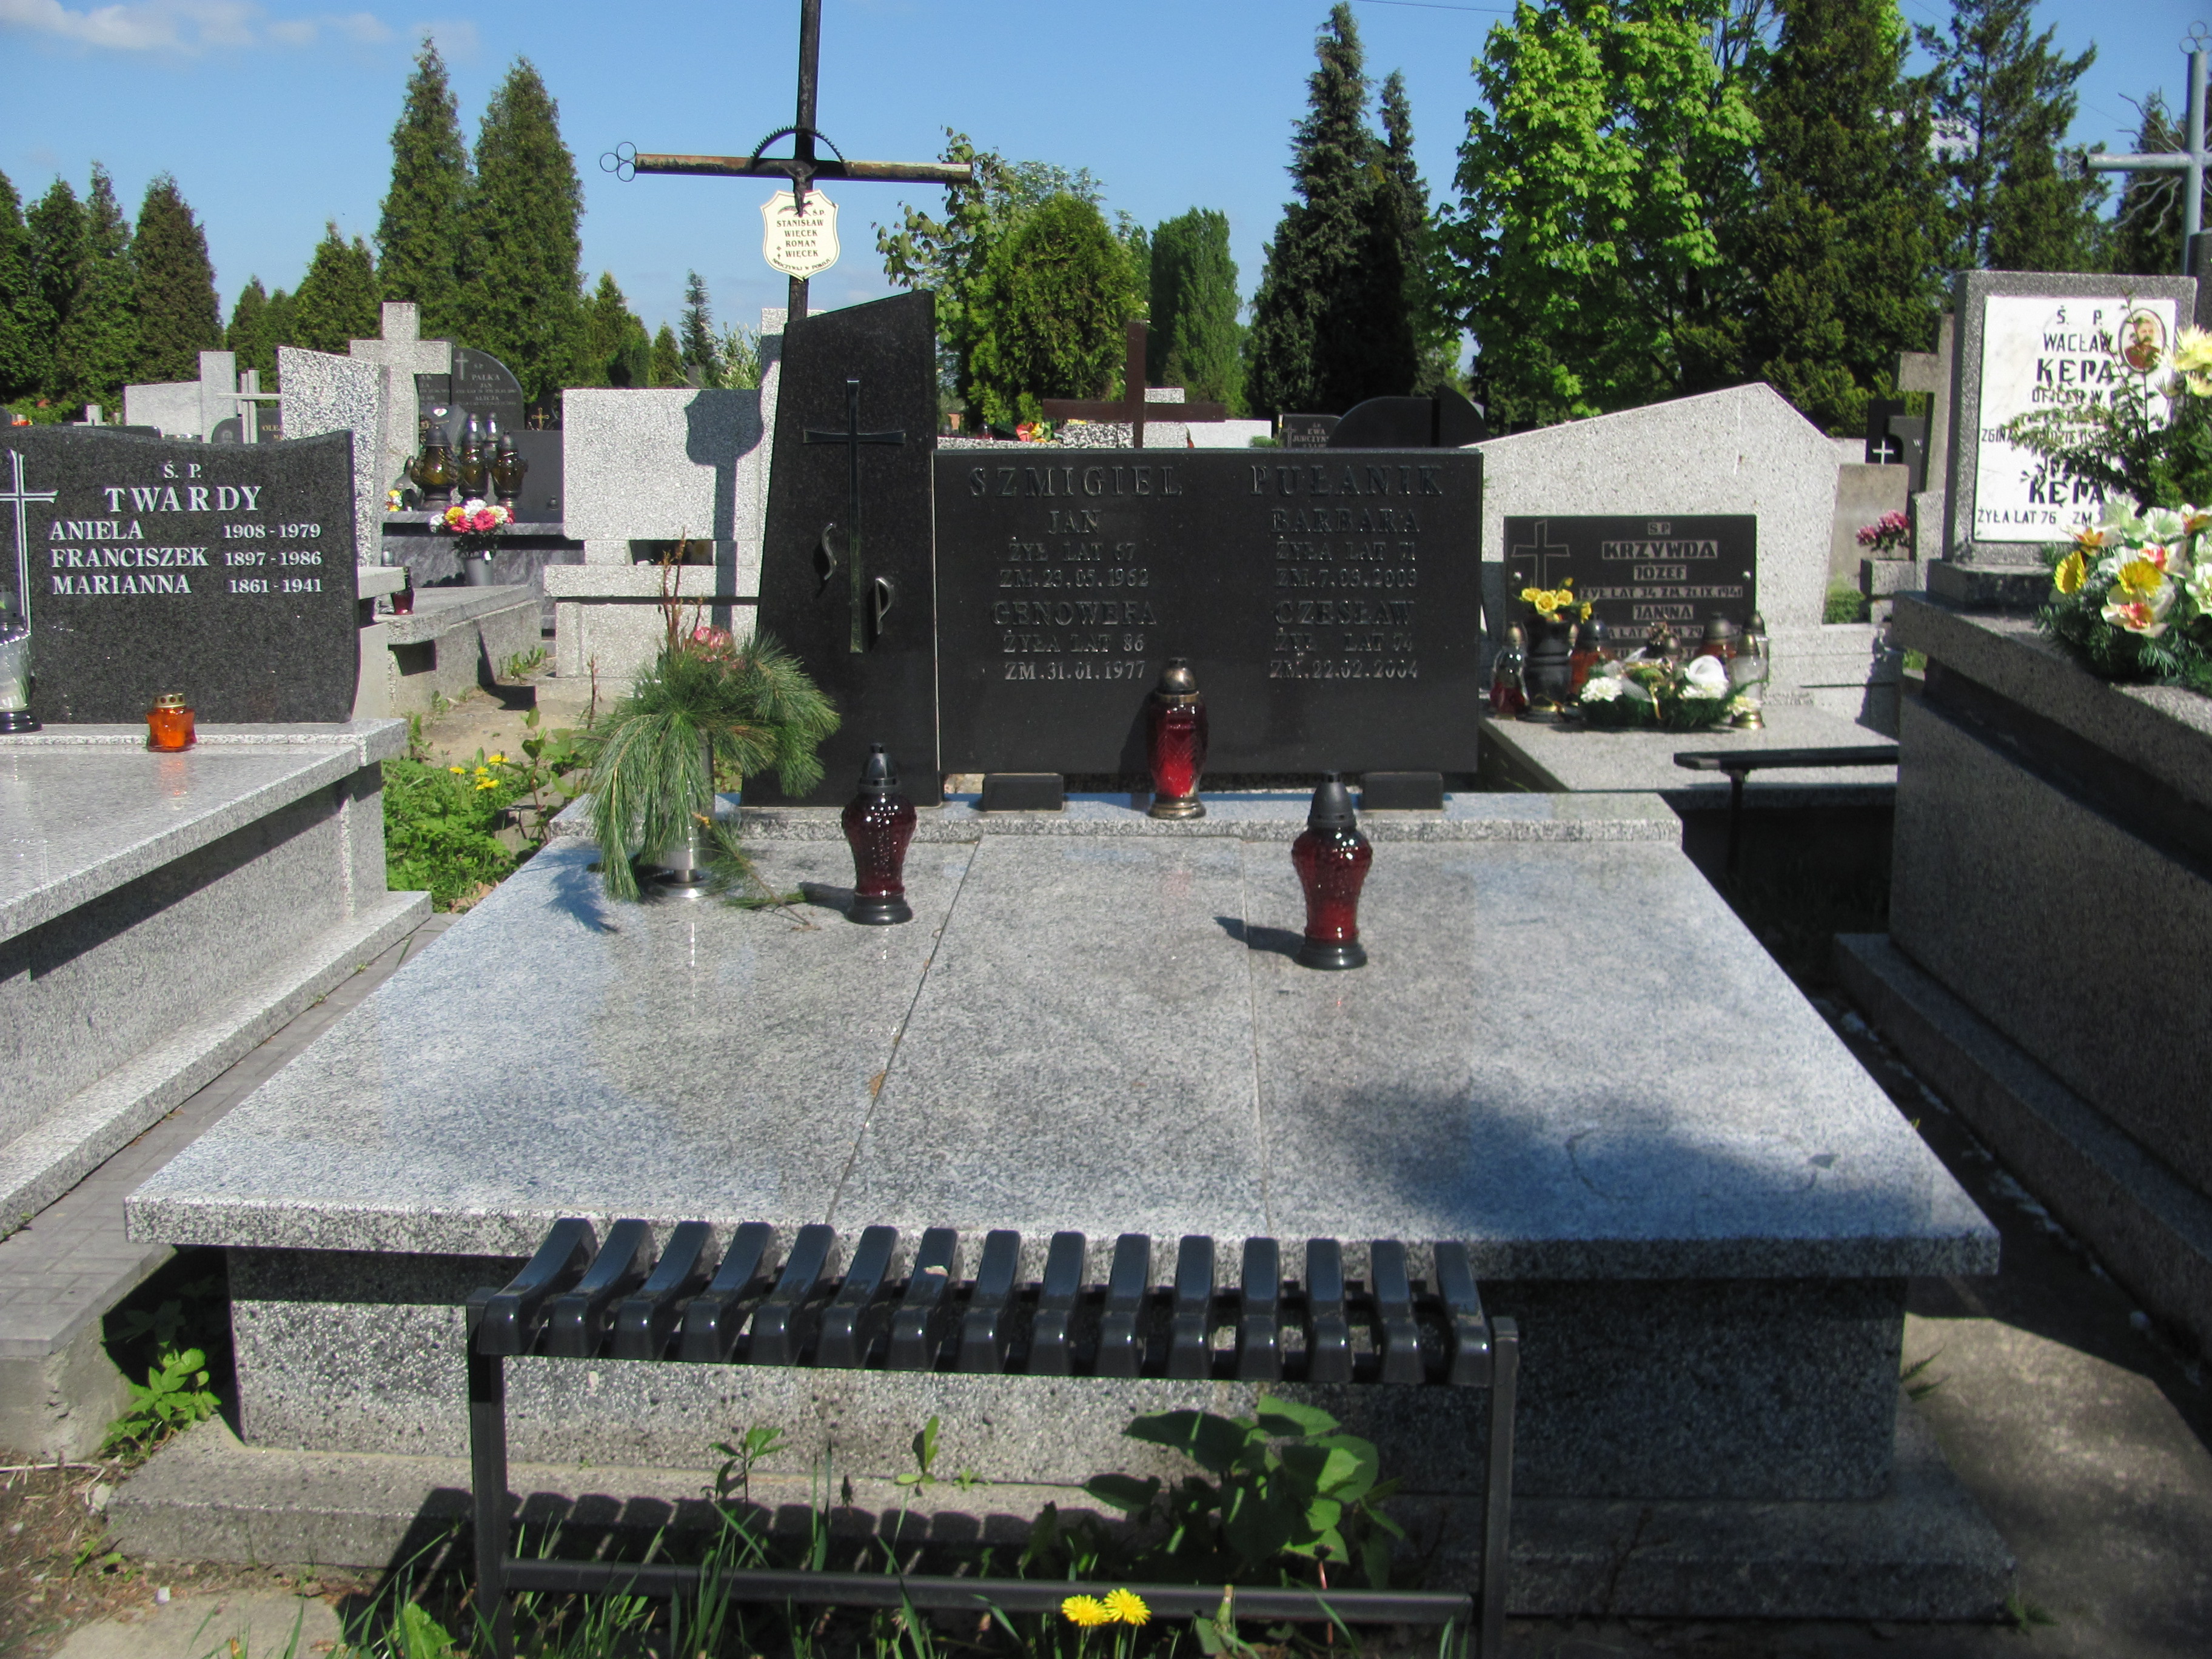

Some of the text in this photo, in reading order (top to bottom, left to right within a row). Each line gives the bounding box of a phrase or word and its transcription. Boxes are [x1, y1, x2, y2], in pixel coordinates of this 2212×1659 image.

[784, 230, 818, 238] WIĘCEK
[785, 250, 819, 259] WIĘCEK
[2037, 358, 2114, 386] KĘPA
[970, 466, 1183, 497] SZMIGIEL
[1250, 465, 1443, 497] PUŁANIK
[105, 485, 263, 513] TWARDY
[2029, 480, 2105, 508] KĘPA
[1048, 509, 1102, 535] JAN
[1270, 508, 1420, 533] BARBARA
[1977, 506, 2010, 524] ŻYŁA
[2014, 510, 2037, 524] LAT
[2040, 510, 2057, 525] 76
[49, 520, 145, 541] ANIELA
[50, 547, 210, 568] FRANCISZEK
[1062, 541, 1105, 562] LAT
[1114, 543, 1138, 562] 67
[1345, 541, 1387, 561] LAT
[52, 574, 193, 595] MARIANNA
[990, 600, 1158, 626] GENOWEFA
[1275, 599, 1415, 626] CZESŁAW
[1636, 606, 1692, 618] JANINA
[1070, 634, 1112, 653] LAT
[1122, 633, 1145, 653] 86
[1344, 632, 1385, 652] LAT
